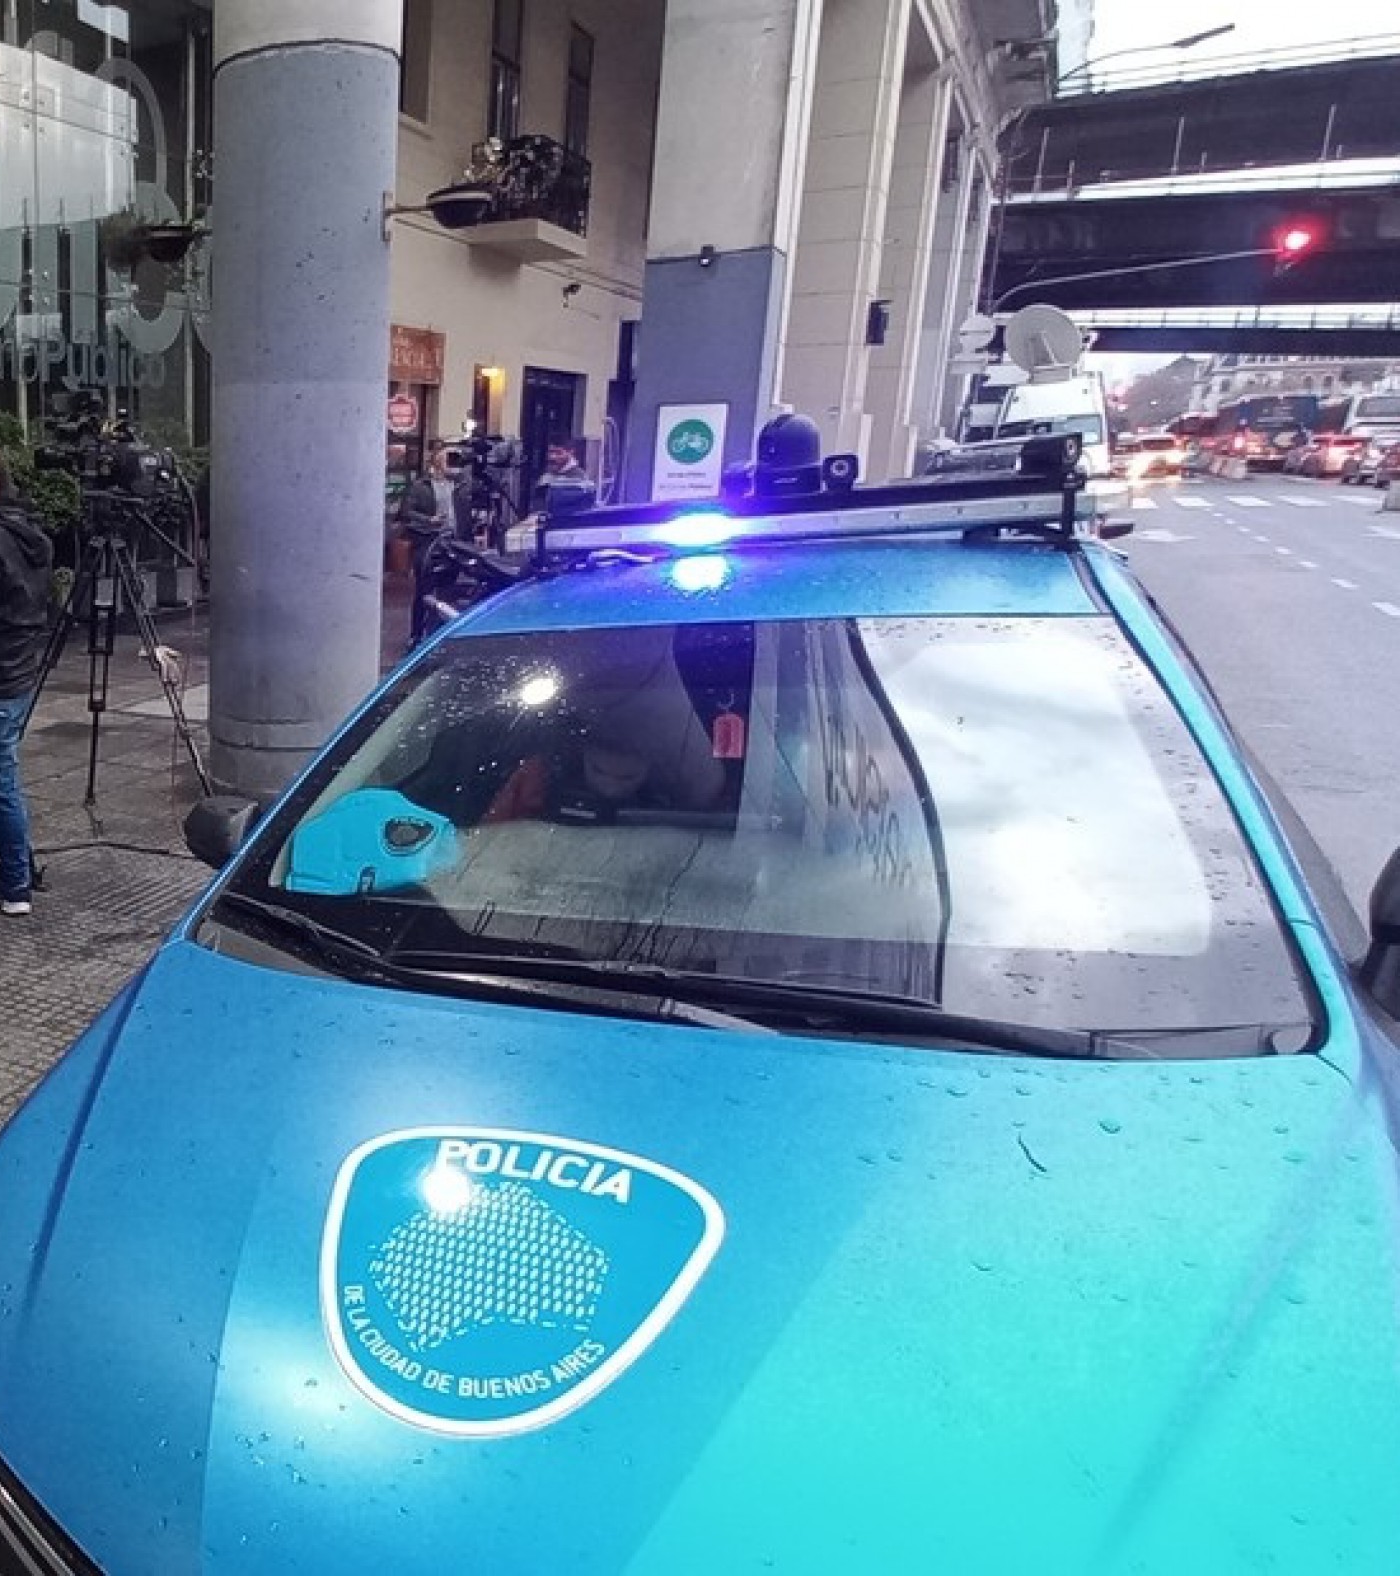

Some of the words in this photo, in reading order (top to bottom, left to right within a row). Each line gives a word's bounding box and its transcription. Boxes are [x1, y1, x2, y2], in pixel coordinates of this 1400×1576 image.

[435, 1138, 633, 1205] POLICIA
[344, 1284, 367, 1307] DE
[347, 1305, 371, 1332] LA
[359, 1328, 422, 1381] CIUDAD
[549, 1338, 606, 1383] AIRES
[422, 1368, 455, 1394] DE
[457, 1369, 552, 1399] BUENOS
